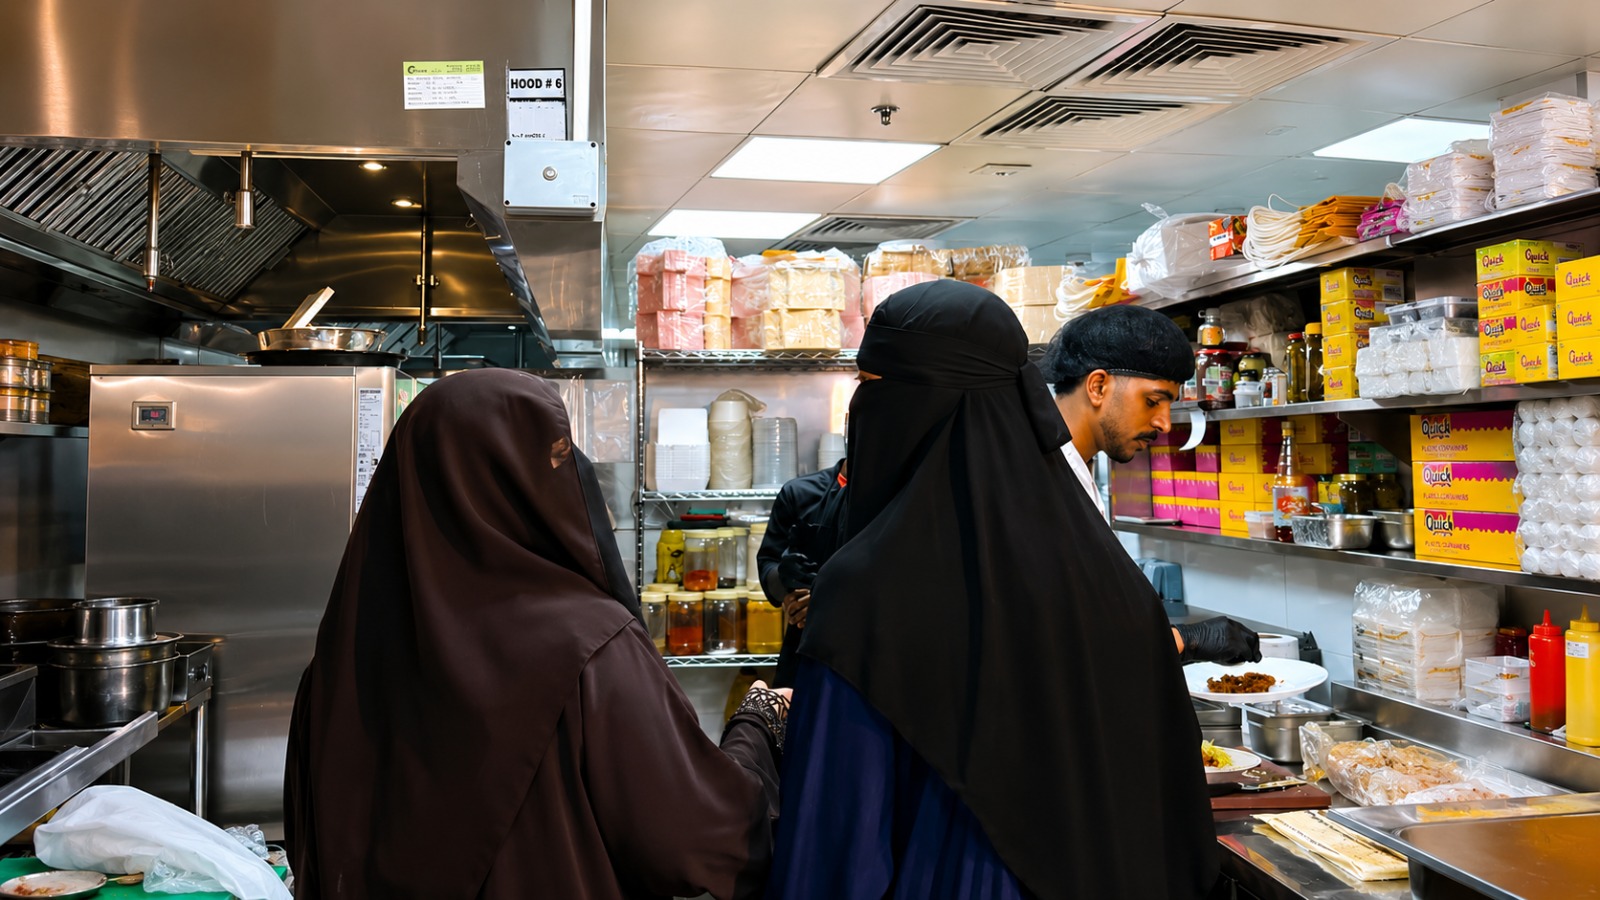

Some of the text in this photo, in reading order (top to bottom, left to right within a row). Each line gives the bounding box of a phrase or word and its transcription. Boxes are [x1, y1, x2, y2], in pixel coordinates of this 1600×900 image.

[510, 78, 563, 89] HOOD # 6
[1525, 248, 1550, 264] Quick
[1565, 271, 1591, 286] Quick
[1567, 310, 1592, 326] Quick
[1568, 350, 1593, 364] Quick
[1422, 417, 1451, 439] Quick
[1423, 467, 1452, 485] Quick
[1425, 514, 1454, 532] Quick
